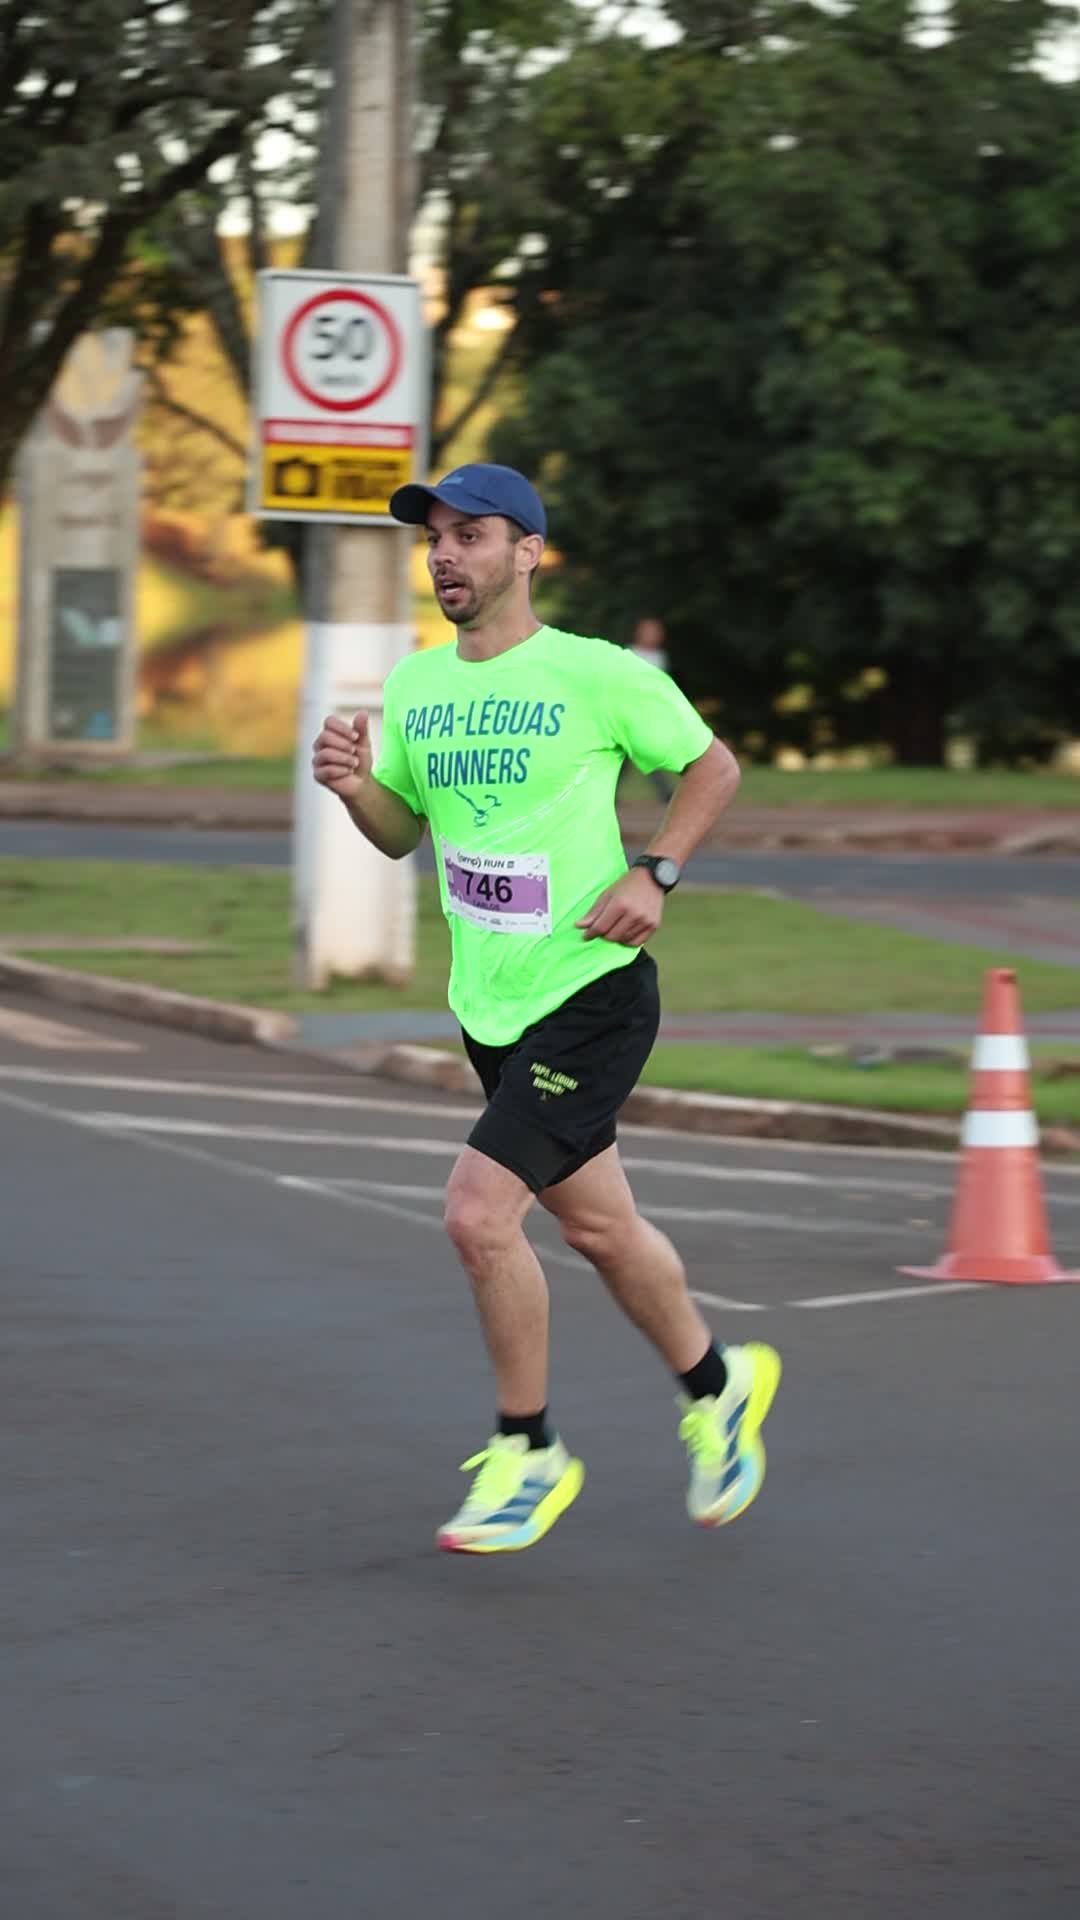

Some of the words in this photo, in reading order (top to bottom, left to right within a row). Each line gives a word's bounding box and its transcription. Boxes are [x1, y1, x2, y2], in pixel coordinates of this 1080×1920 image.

[311, 315, 376, 362] 50
[405, 693, 565, 744] PAPA-LÉGUAS
[427, 747, 530, 789] RUNNERS
[484, 859, 505, 869] RUN
[461, 869, 513, 904] 746
